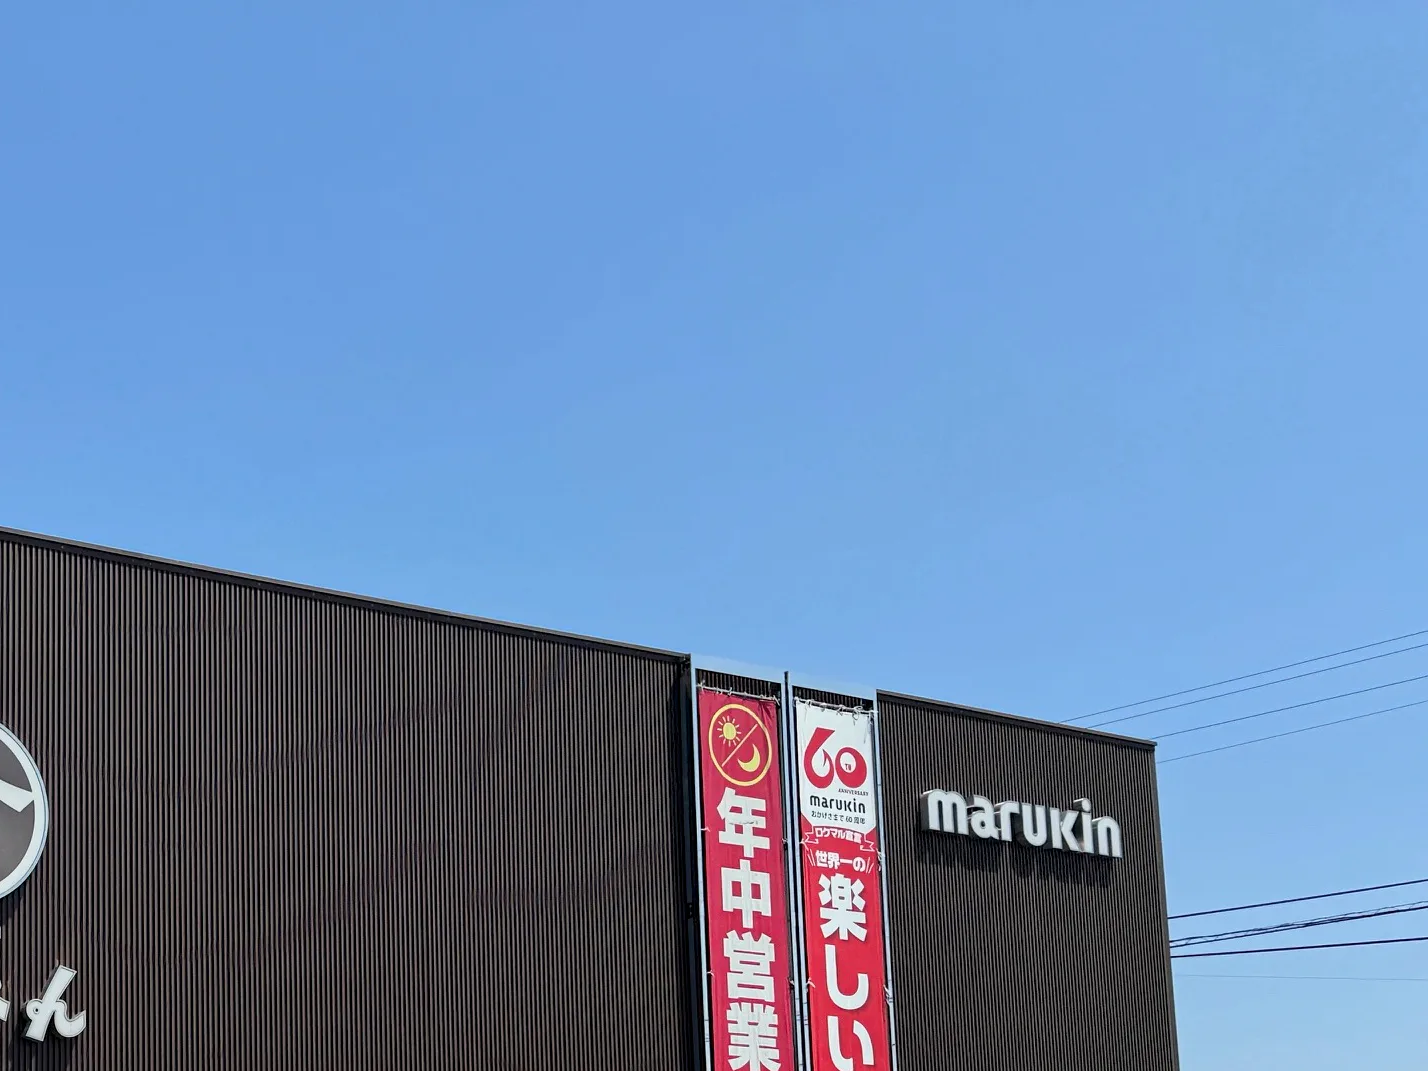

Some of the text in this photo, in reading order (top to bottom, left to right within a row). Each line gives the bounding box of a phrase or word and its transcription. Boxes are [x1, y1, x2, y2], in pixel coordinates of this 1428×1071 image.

[809, 794, 866, 814] marukin
[924, 788, 1123, 859] marukin
[815, 850, 866, 872] 世界一の
